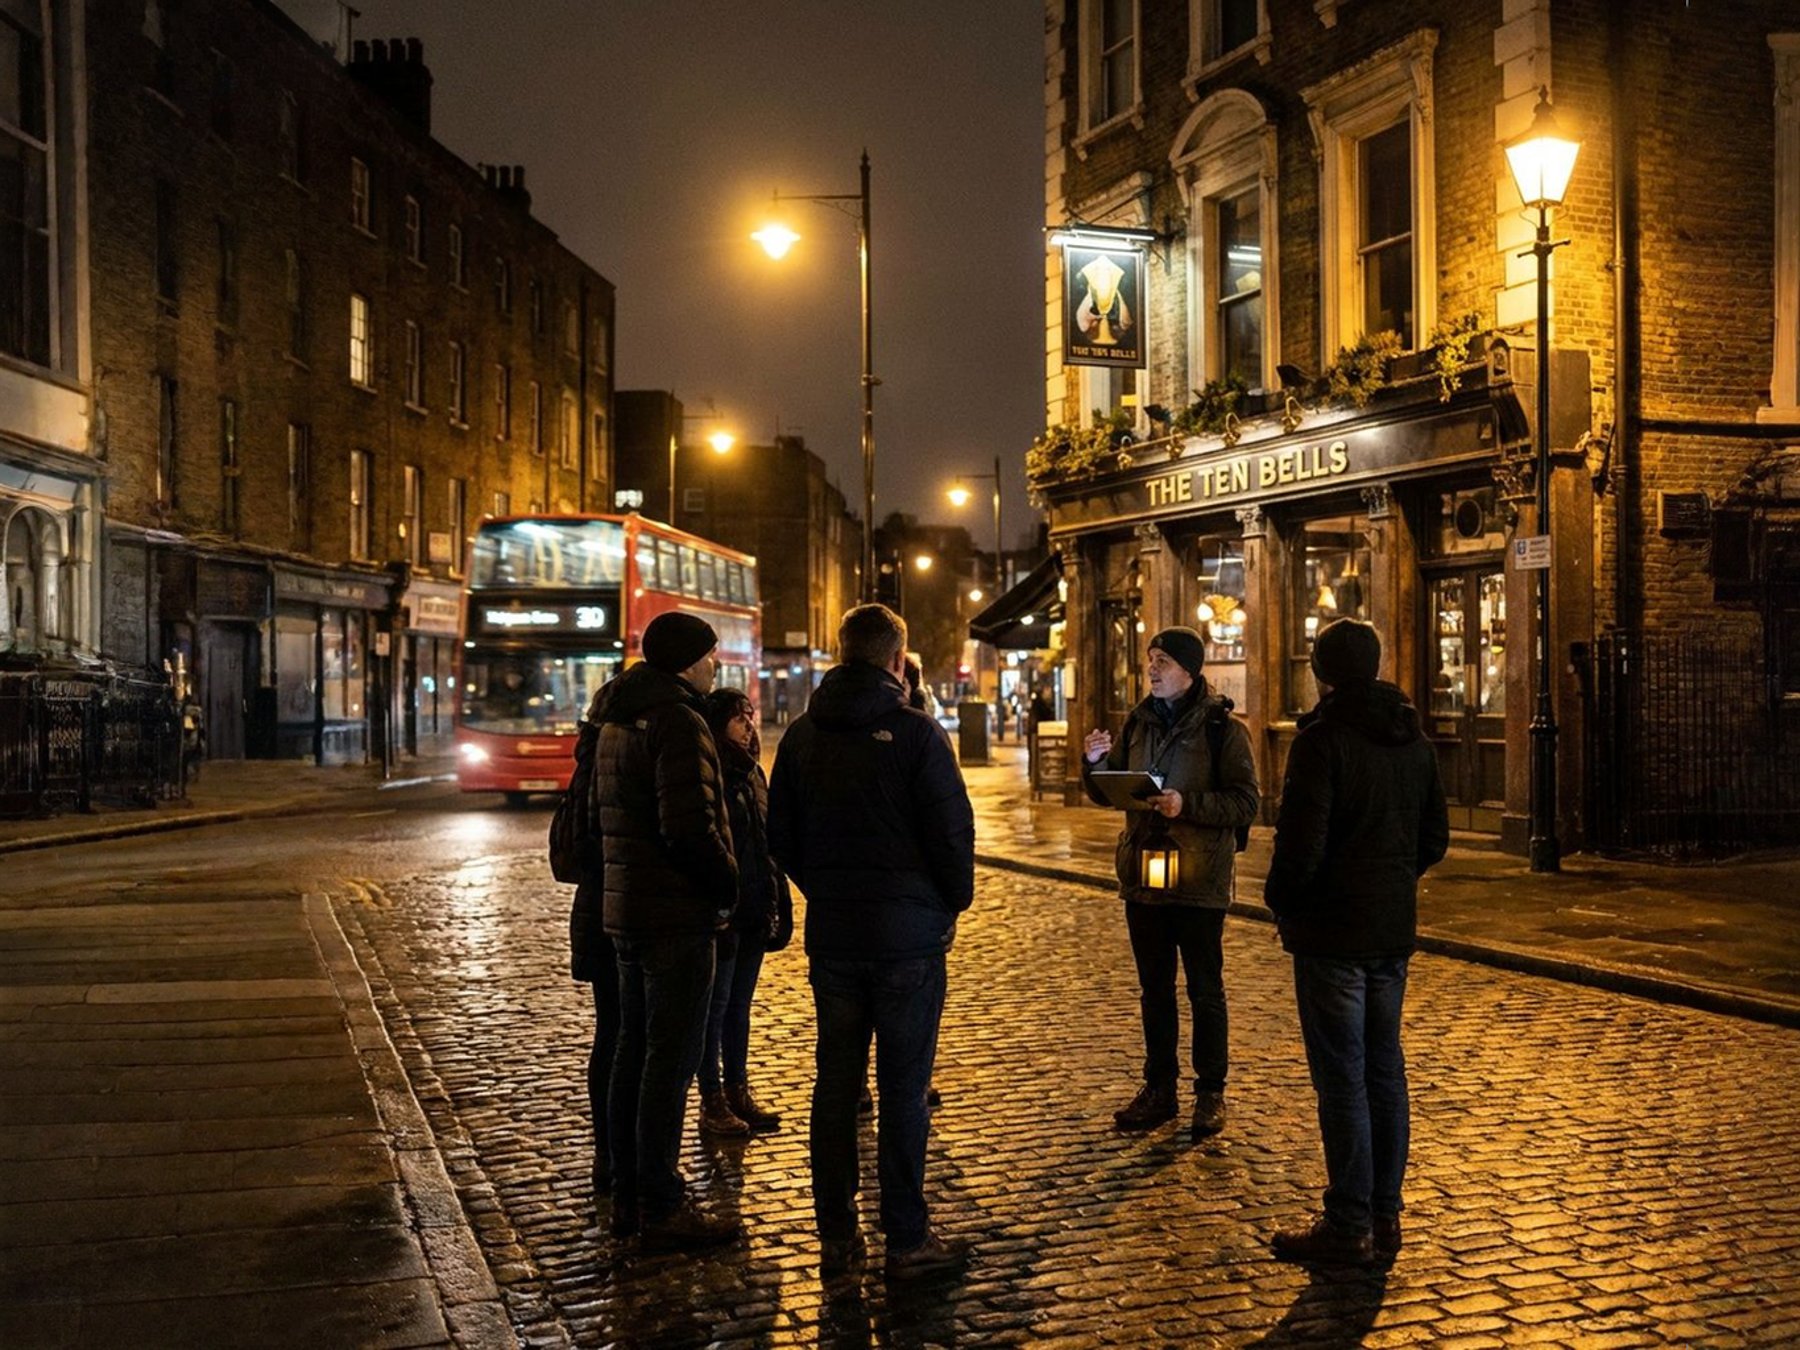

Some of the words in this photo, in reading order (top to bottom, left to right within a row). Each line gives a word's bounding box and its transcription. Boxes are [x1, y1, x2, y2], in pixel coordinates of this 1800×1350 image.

[1146, 471, 1193, 506] THE
[1198, 459, 1250, 497] TEN
[1259, 440, 1349, 487] BELLS
